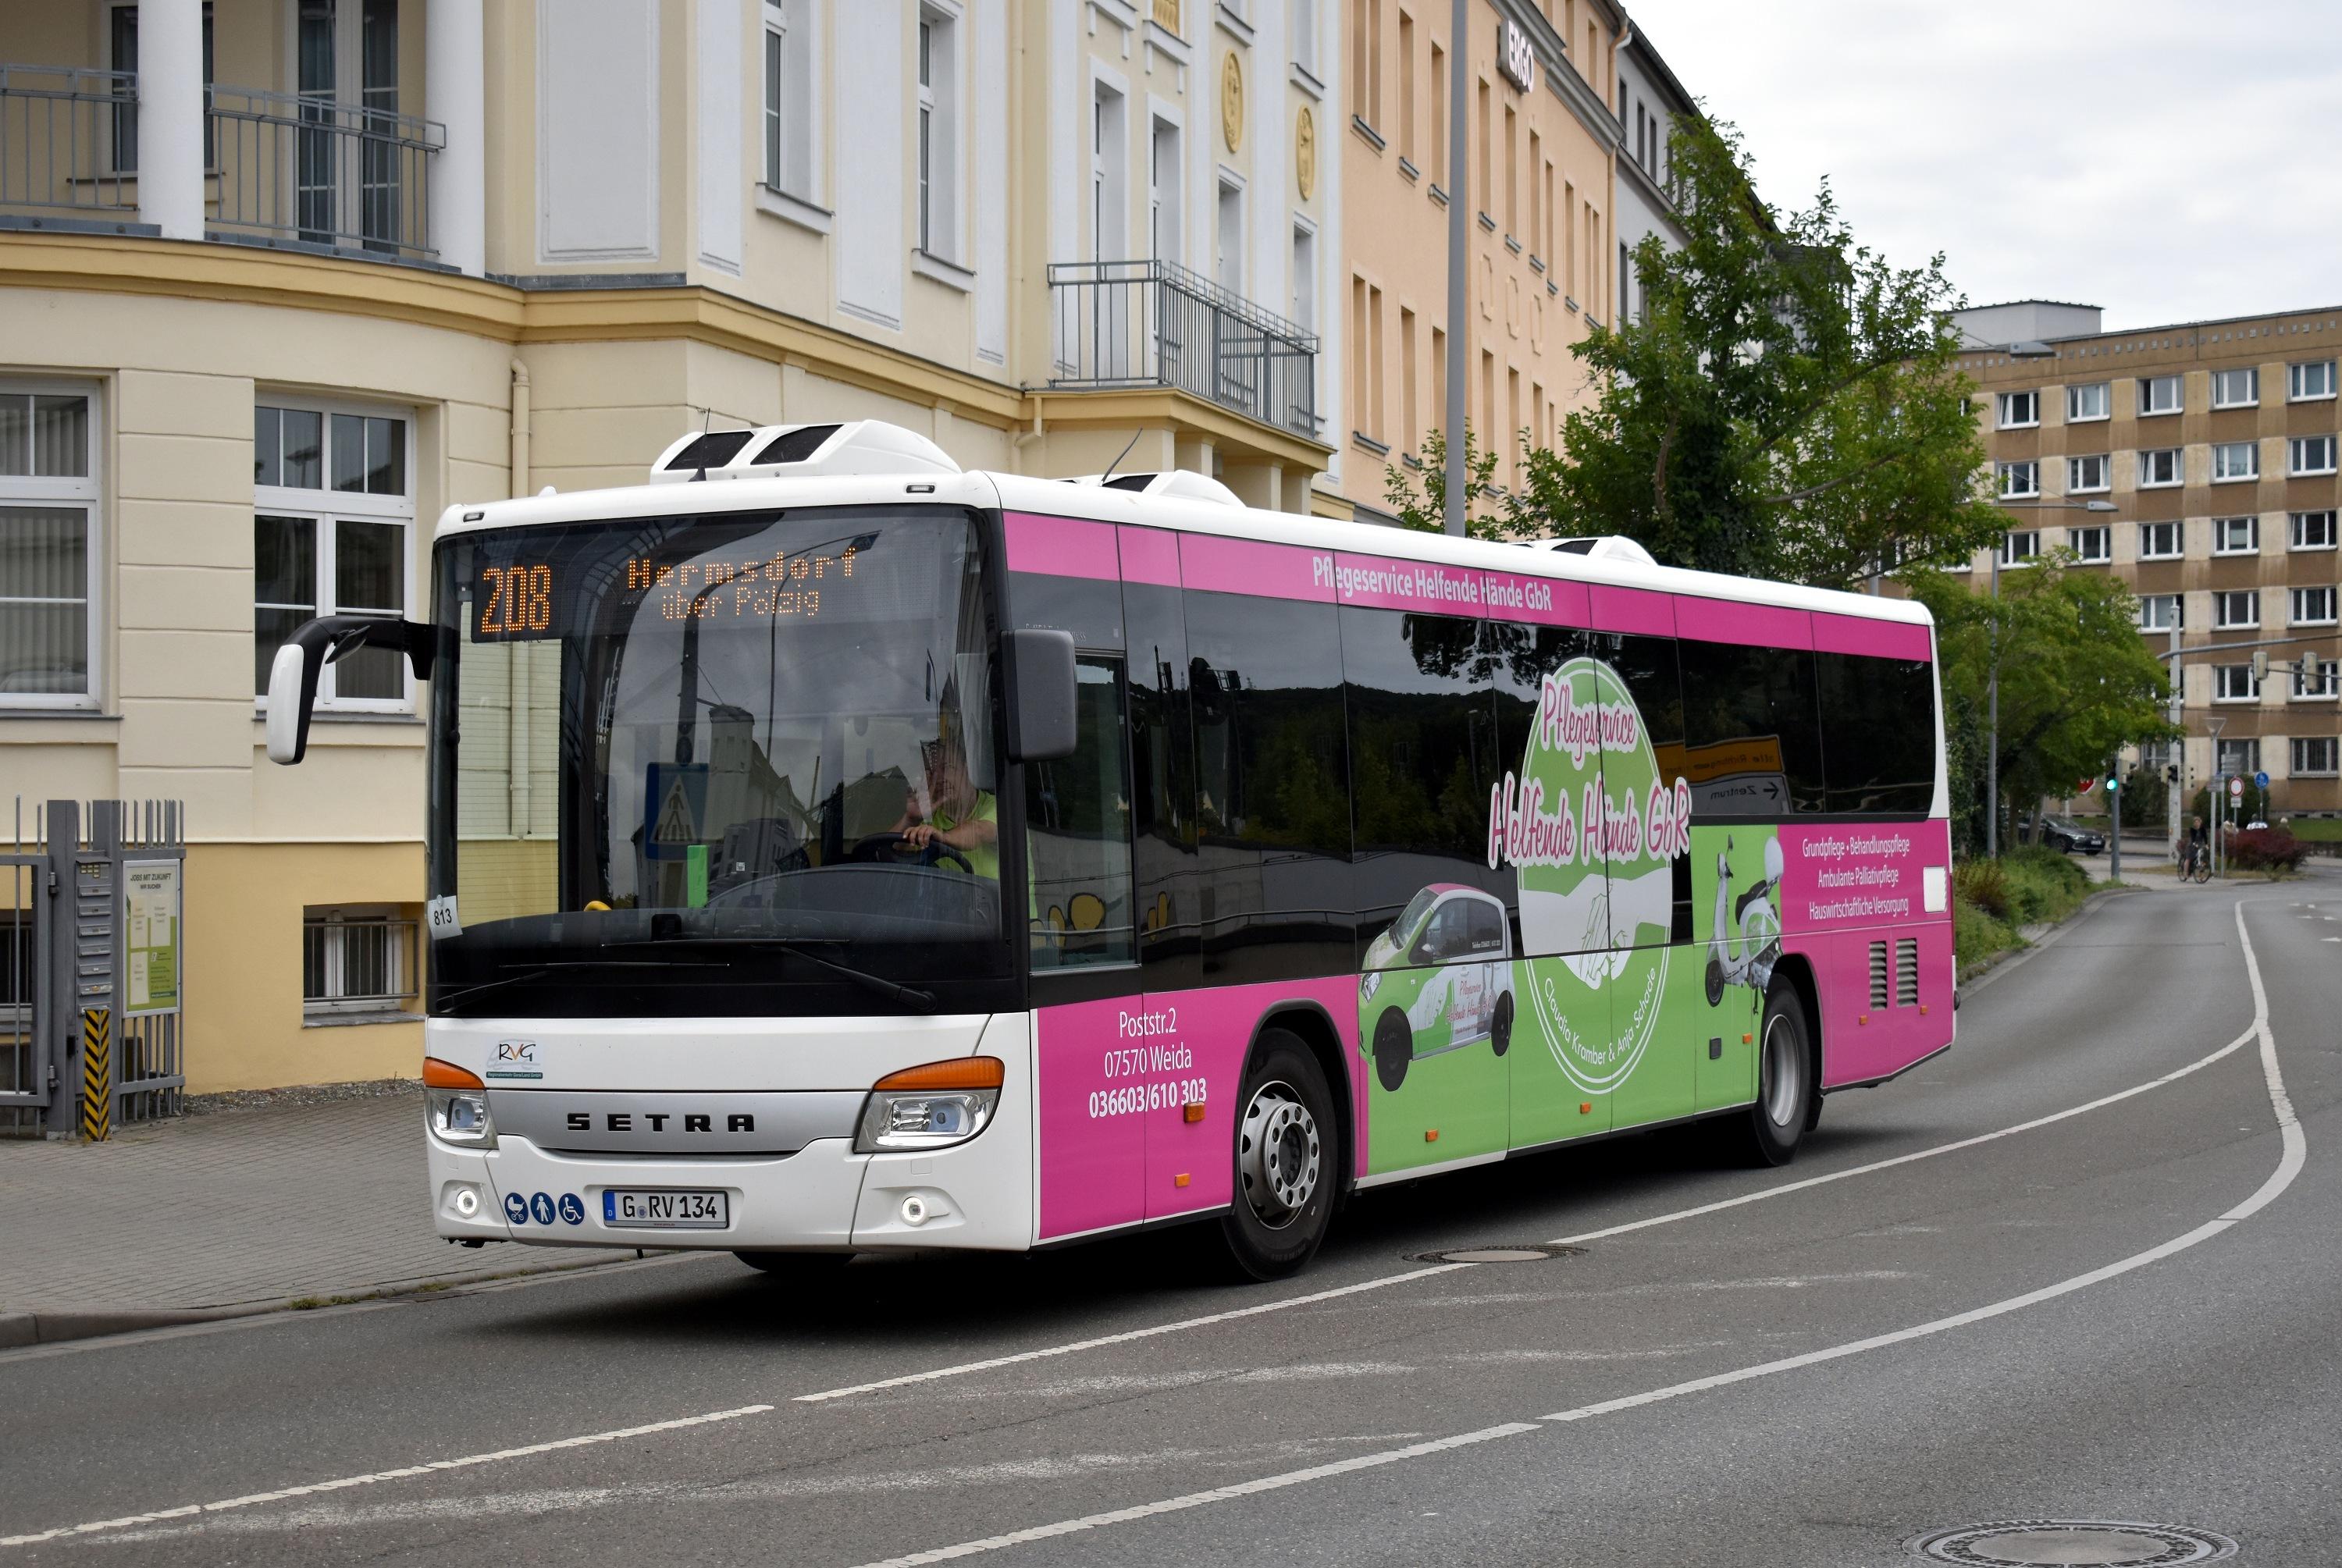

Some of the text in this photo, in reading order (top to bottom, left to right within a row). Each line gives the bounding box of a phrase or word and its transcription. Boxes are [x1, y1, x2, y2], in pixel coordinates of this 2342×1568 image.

[1508, 20, 1534, 94] ERGO
[628, 546, 856, 590] Hermsdorf
[1312, 556, 1553, 611] Pflegeservice Helfende Hände GbR
[481, 564, 551, 633] 208
[662, 581, 820, 620] über Pölzig
[1542, 681, 1635, 762] Pflegeservice
[1491, 779, 1689, 862] Helfende Hände GbR
[1803, 834, 1910, 861] Grundpflege Behandlungspflege
[1818, 864, 1899, 888] Ambulante Palliativpflege
[434, 908, 452, 926] 813
[1810, 897, 1909, 920] Hauswirtschaftliche Versorgung
[1545, 968, 1656, 1065] Claudia Kramber & Anja Schade
[499, 1044, 536, 1061] RVG
[1105, 1042, 1192, 1078] 07570 Weida
[1089, 1078, 1207, 1118] 036603/610 303
[566, 1112, 755, 1132] SETRA
[623, 1196, 717, 1218] G RV 134
